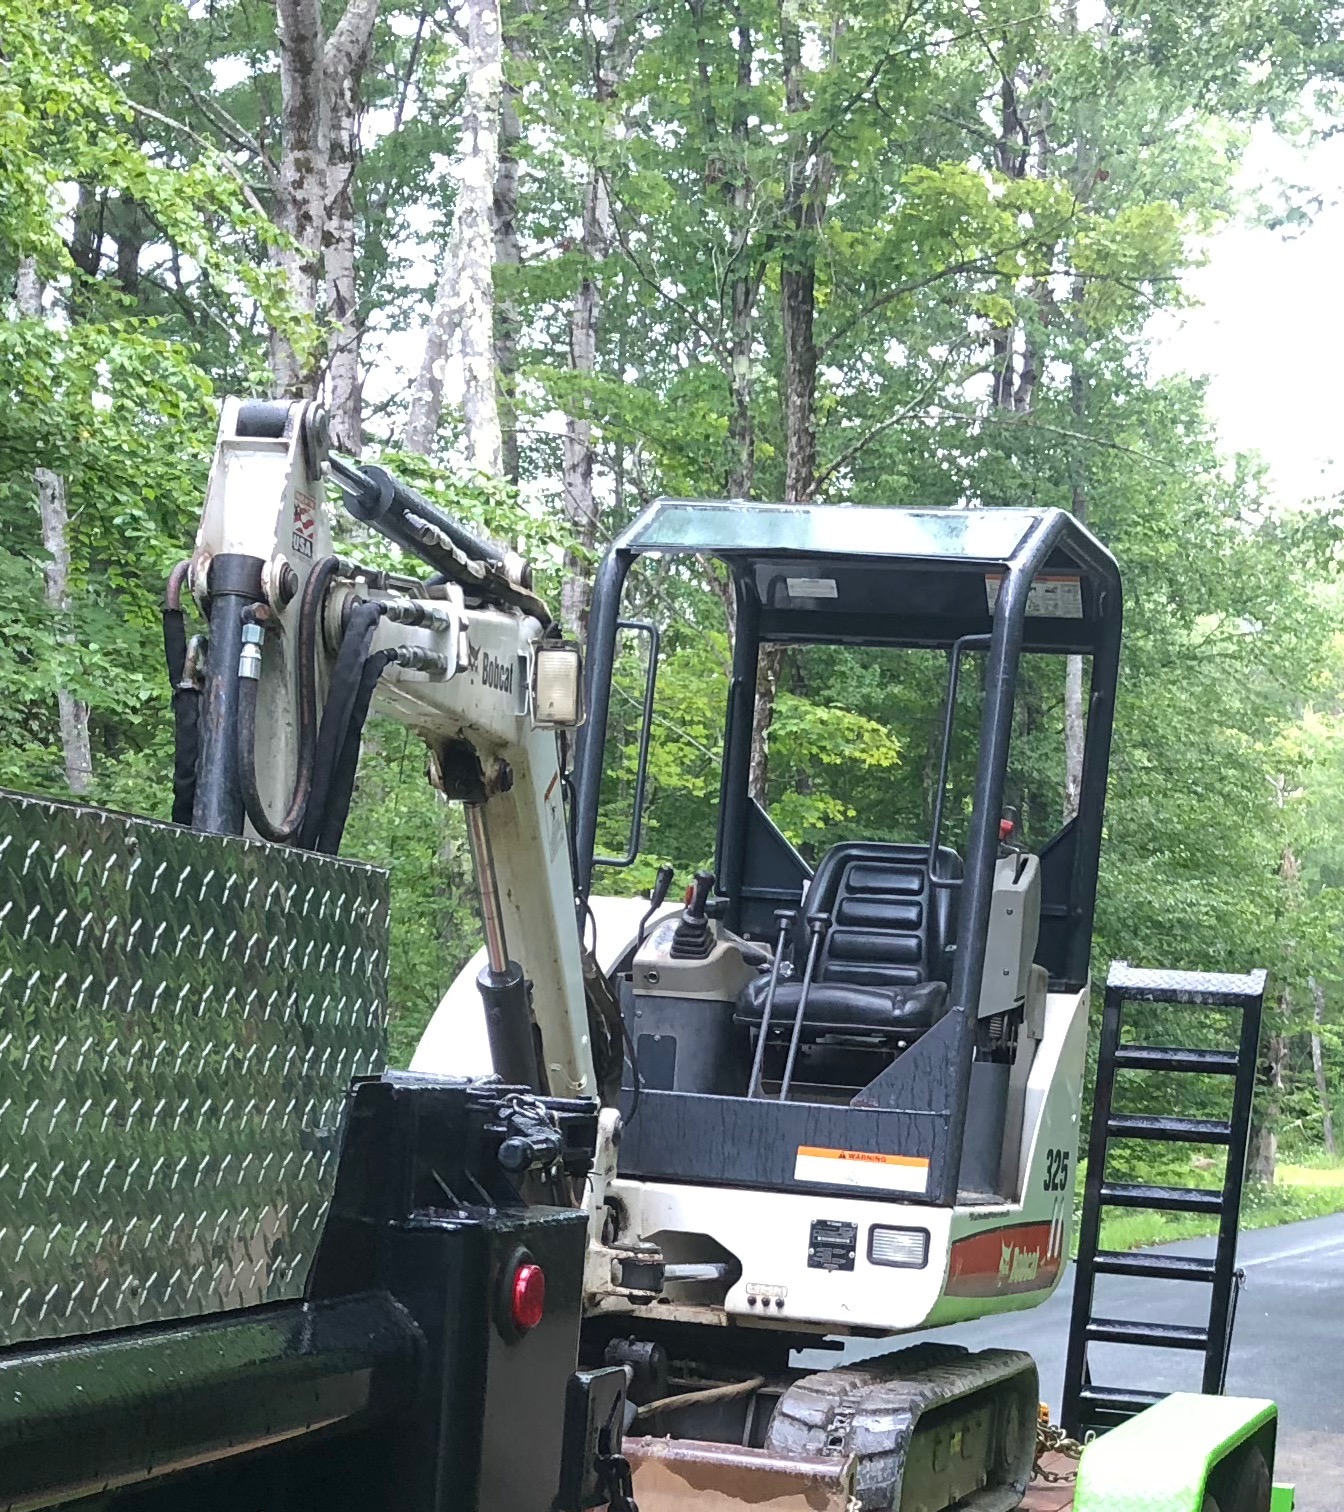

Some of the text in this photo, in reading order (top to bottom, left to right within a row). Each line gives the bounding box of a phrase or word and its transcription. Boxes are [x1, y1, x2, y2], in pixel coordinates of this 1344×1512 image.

[293, 533, 312, 557] USA
[482, 652, 513, 695] Bobcat
[848, 1153, 887, 1163] WARNING
[1043, 1148, 1070, 1191] 325
